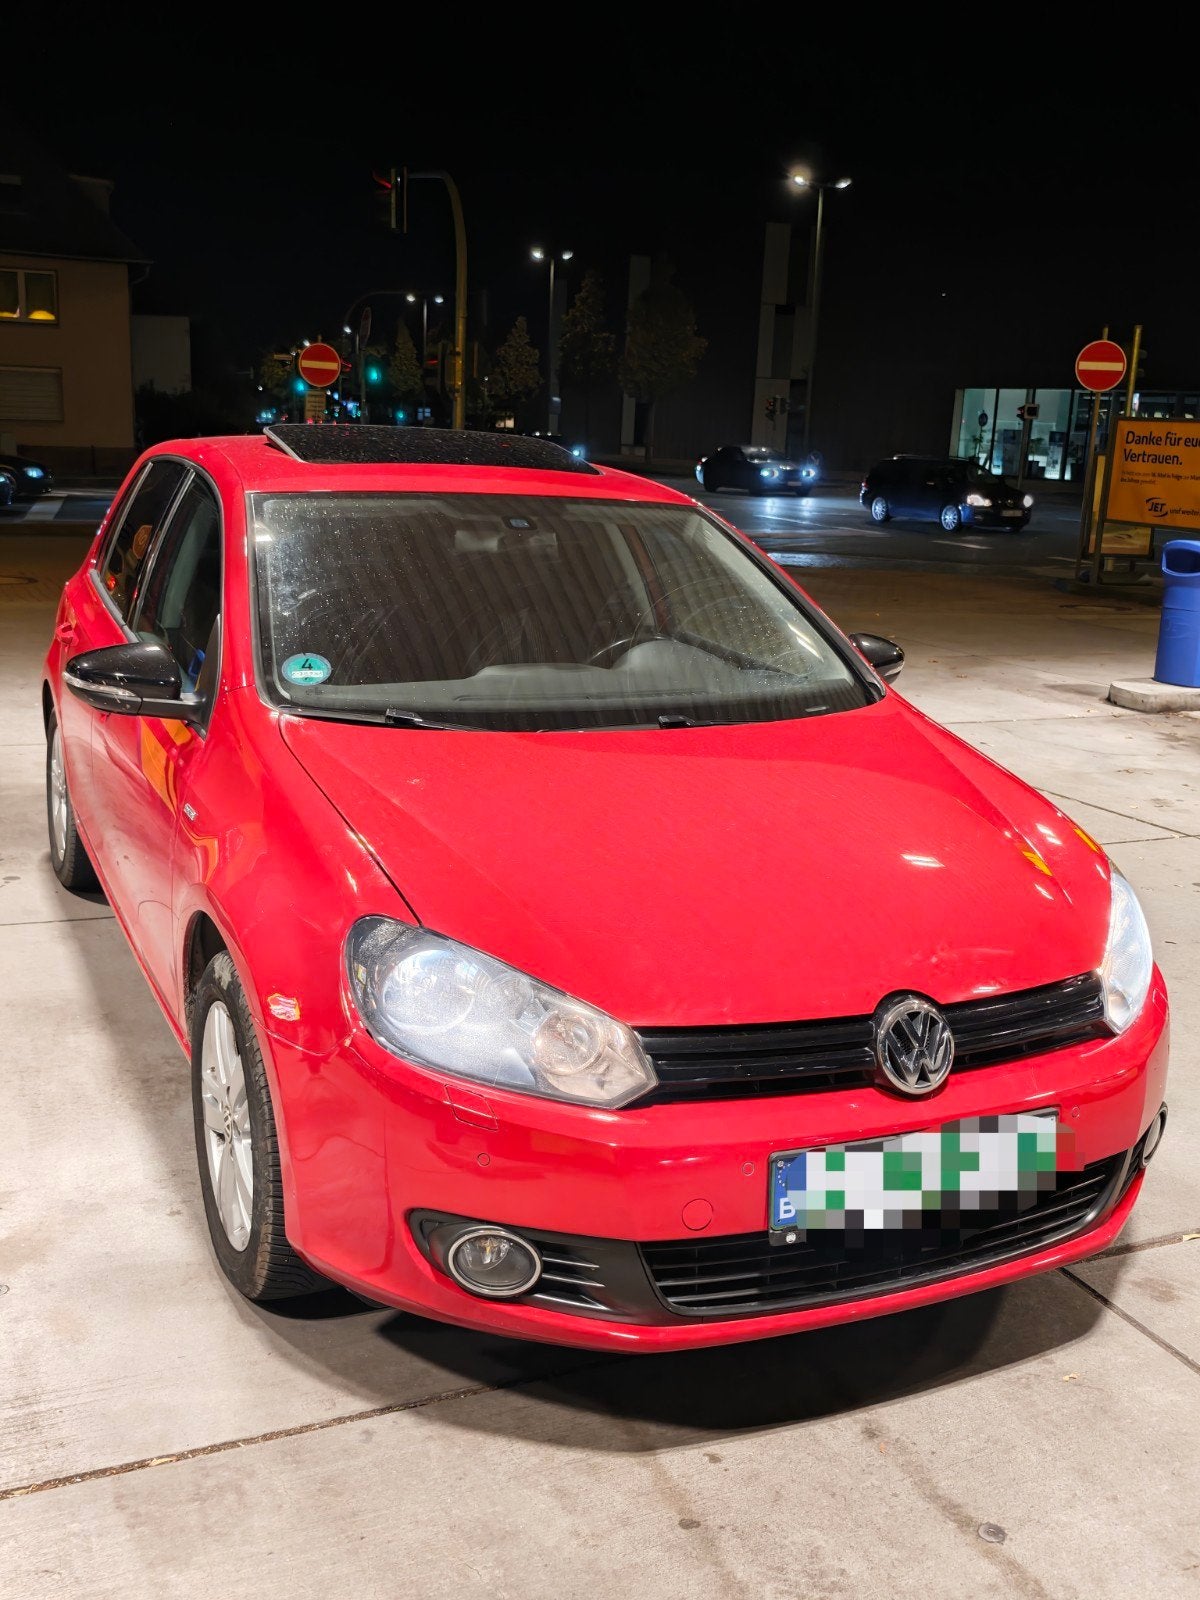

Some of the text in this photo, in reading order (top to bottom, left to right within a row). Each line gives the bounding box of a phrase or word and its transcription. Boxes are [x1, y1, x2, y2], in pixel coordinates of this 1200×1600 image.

[1125, 430, 1200, 448] Danke für eu
[1123, 448, 1183, 466] Vertrauen.
[1148, 501, 1167, 513] JET
[302, 658, 313, 670] 4
